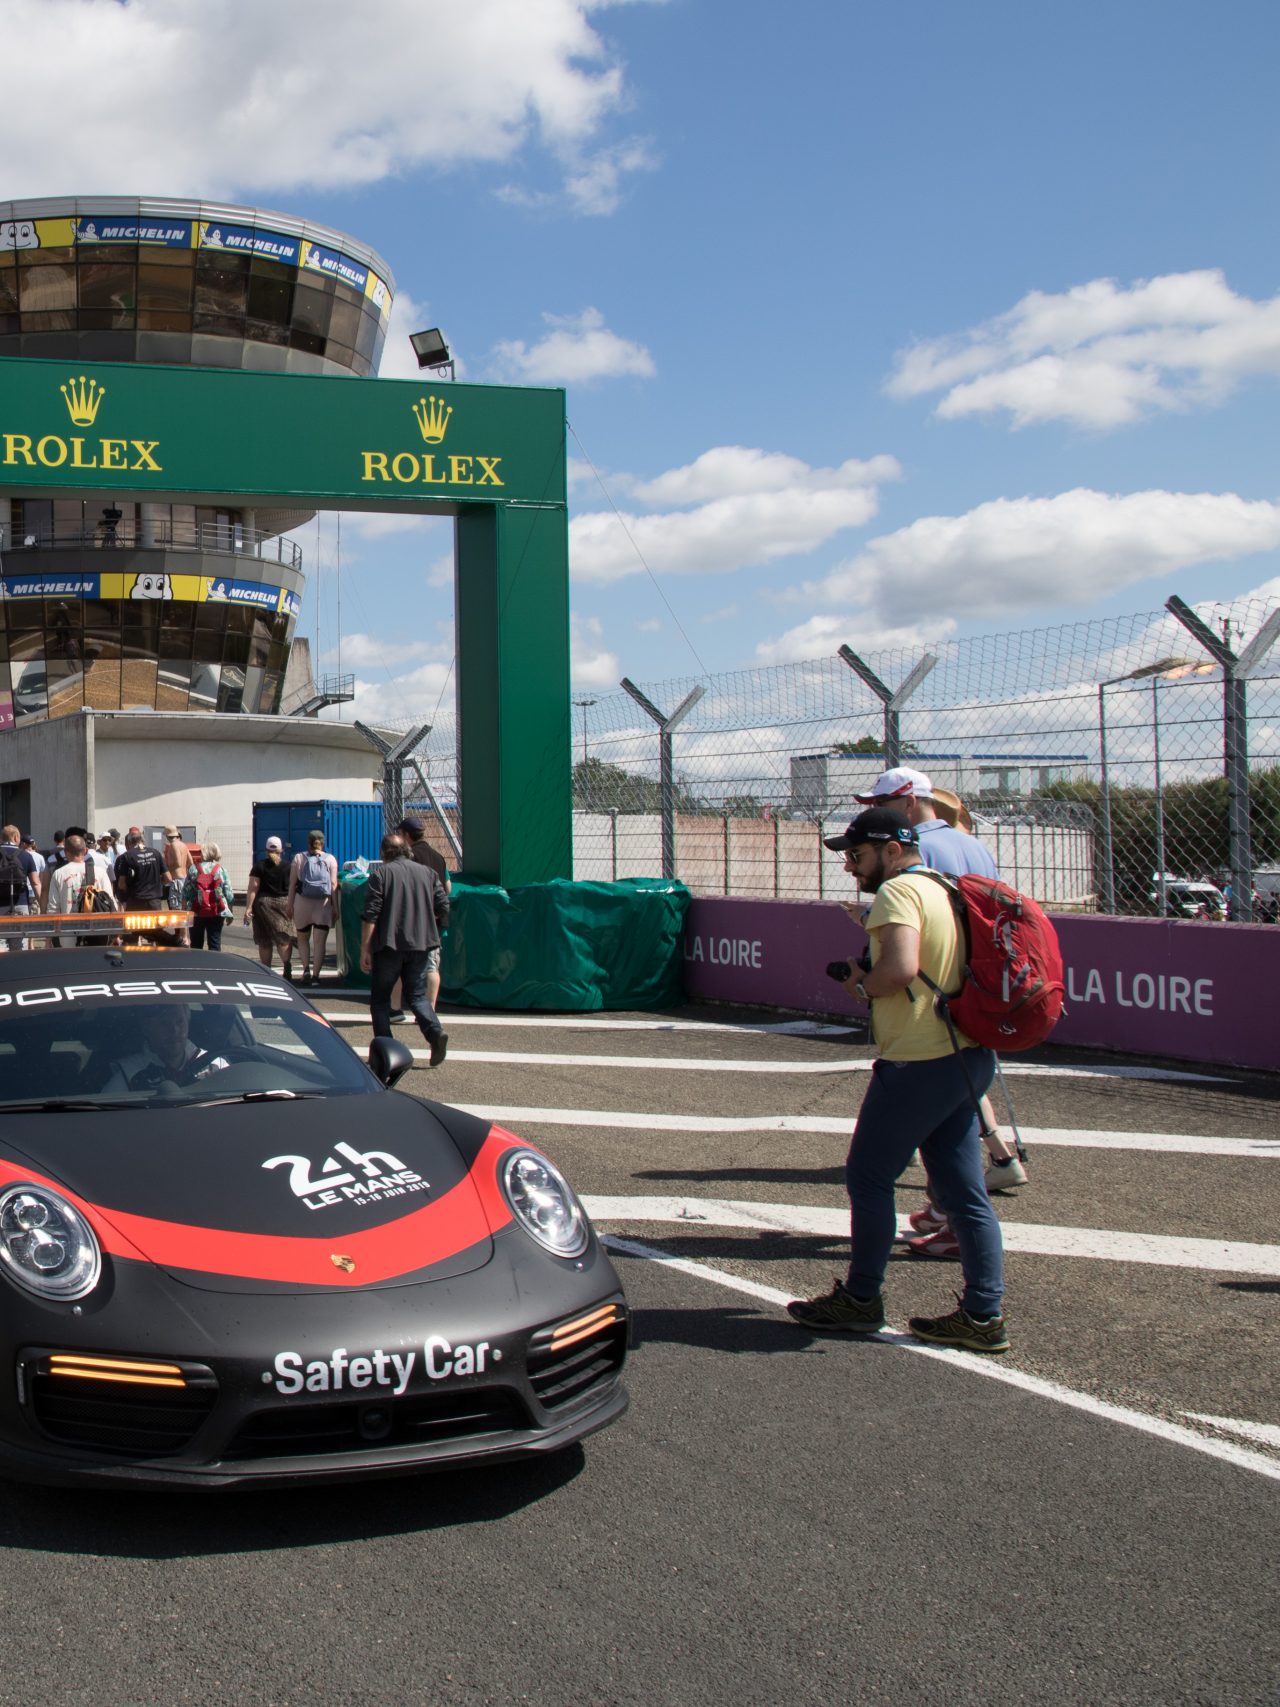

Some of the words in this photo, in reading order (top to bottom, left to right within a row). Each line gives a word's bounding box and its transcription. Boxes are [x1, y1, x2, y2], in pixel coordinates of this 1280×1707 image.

[102, 227, 185, 240] MICHELIN
[226, 235, 295, 257] MICHELIN
[322, 258, 366, 285] MICHELIN
[2, 434, 163, 471] ROLEX
[361, 451, 505, 486] ROLEX
[13, 582, 94, 594] MICHELIN
[229, 588, 278, 604] MICHELIN
[684, 935, 704, 962] LA
[710, 937, 762, 968] LOIRE
[1068, 967, 1106, 1004] LA
[1116, 971, 1213, 1016] LOIRE
[261, 1141, 407, 1197] 24h
[302, 1190, 344, 1210] LE
[340, 1170, 422, 1199] MANS
[354, 1192, 383, 1206] 15-16
[384, 1186, 406, 1198] JUIN
[408, 1181, 431, 1193] 2019
[274, 1348, 416, 1396] Safety
[424, 1335, 490, 1380] Car
